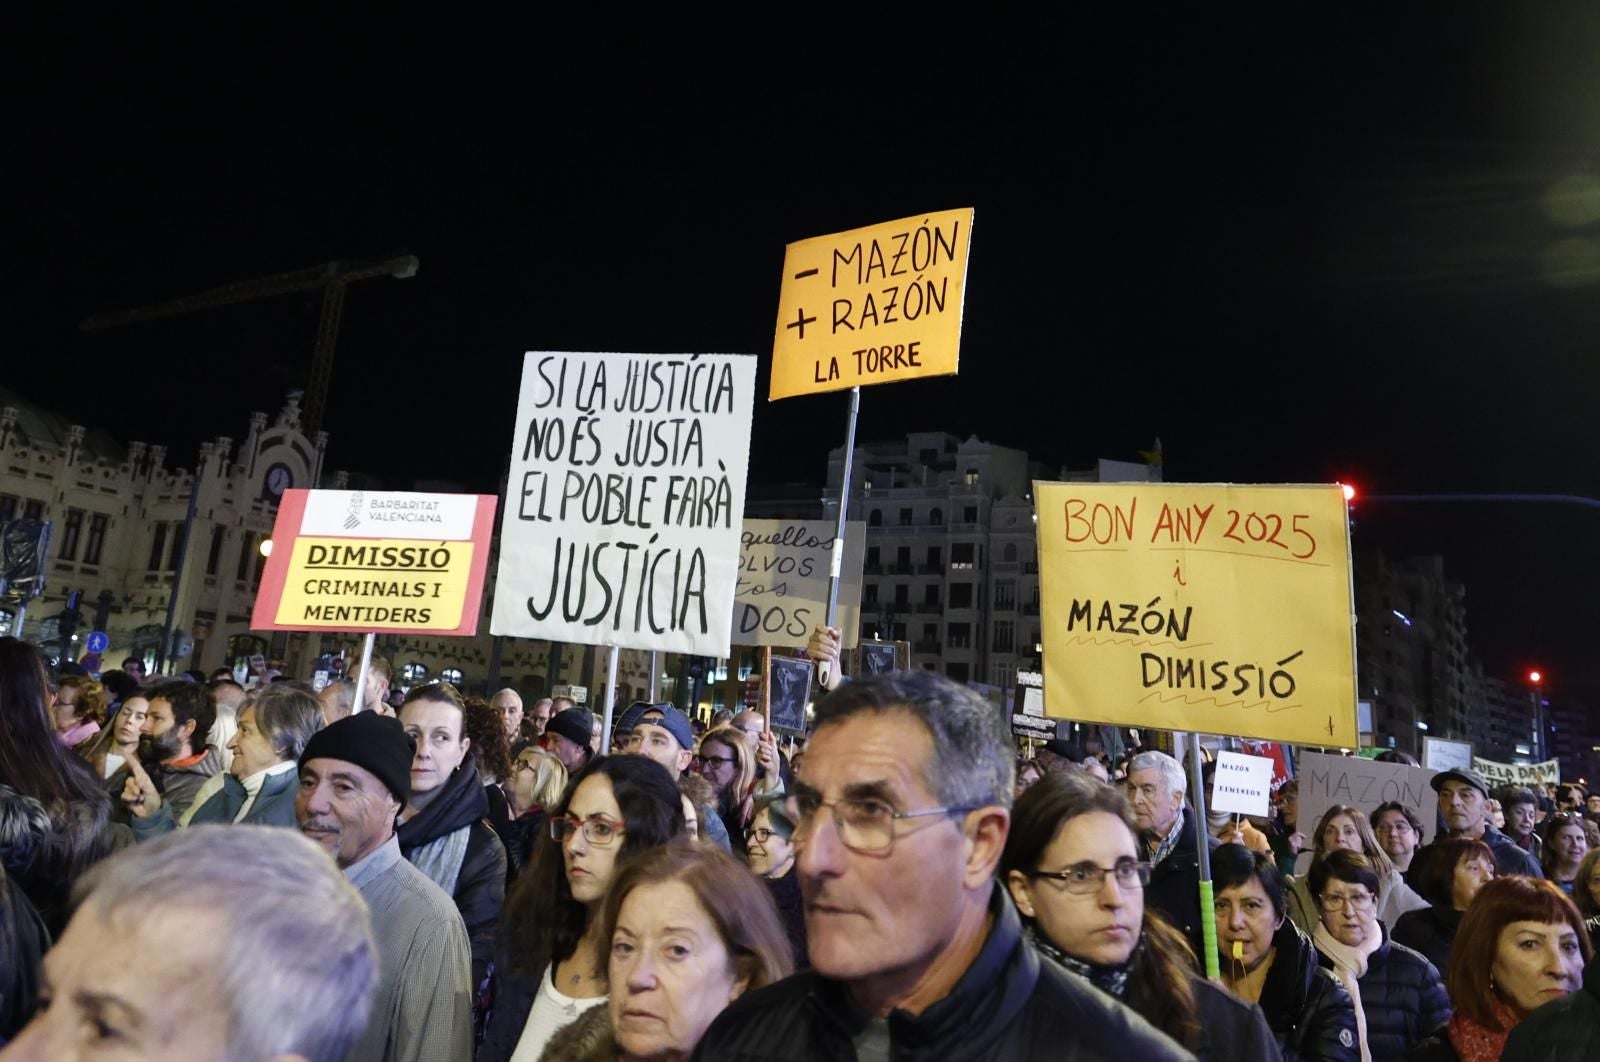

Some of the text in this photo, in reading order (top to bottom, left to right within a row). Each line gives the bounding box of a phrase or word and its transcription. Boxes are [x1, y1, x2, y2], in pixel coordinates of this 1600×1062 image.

[832, 218, 959, 288] MAZÓN
[832, 274, 948, 335] RAZÓN
[535, 353, 734, 415] SI LA JUSTÍCIA
[814, 341, 922, 383] LA TORRE
[522, 409, 703, 468] NO ÉS JUSTA
[370, 499, 441, 512] BARBARITAT
[518, 458, 732, 529] EL POBLE FARÀ
[369, 511, 443, 524] VALENCIANA
[1064, 496, 1316, 559] BON ANY 2025
[307, 541, 451, 568] DIMISSIÓ
[304, 579, 442, 598] CRIMINALS I
[526, 532, 708, 635] JUSTÍCIA
[303, 605, 432, 624] MENTIDERS
[740, 603, 810, 637] DOS
[1067, 596, 1193, 642] MAZÓN
[1140, 650, 1304, 699] DIMISSIÓ
[1310, 768, 1425, 808] MAZÓN
